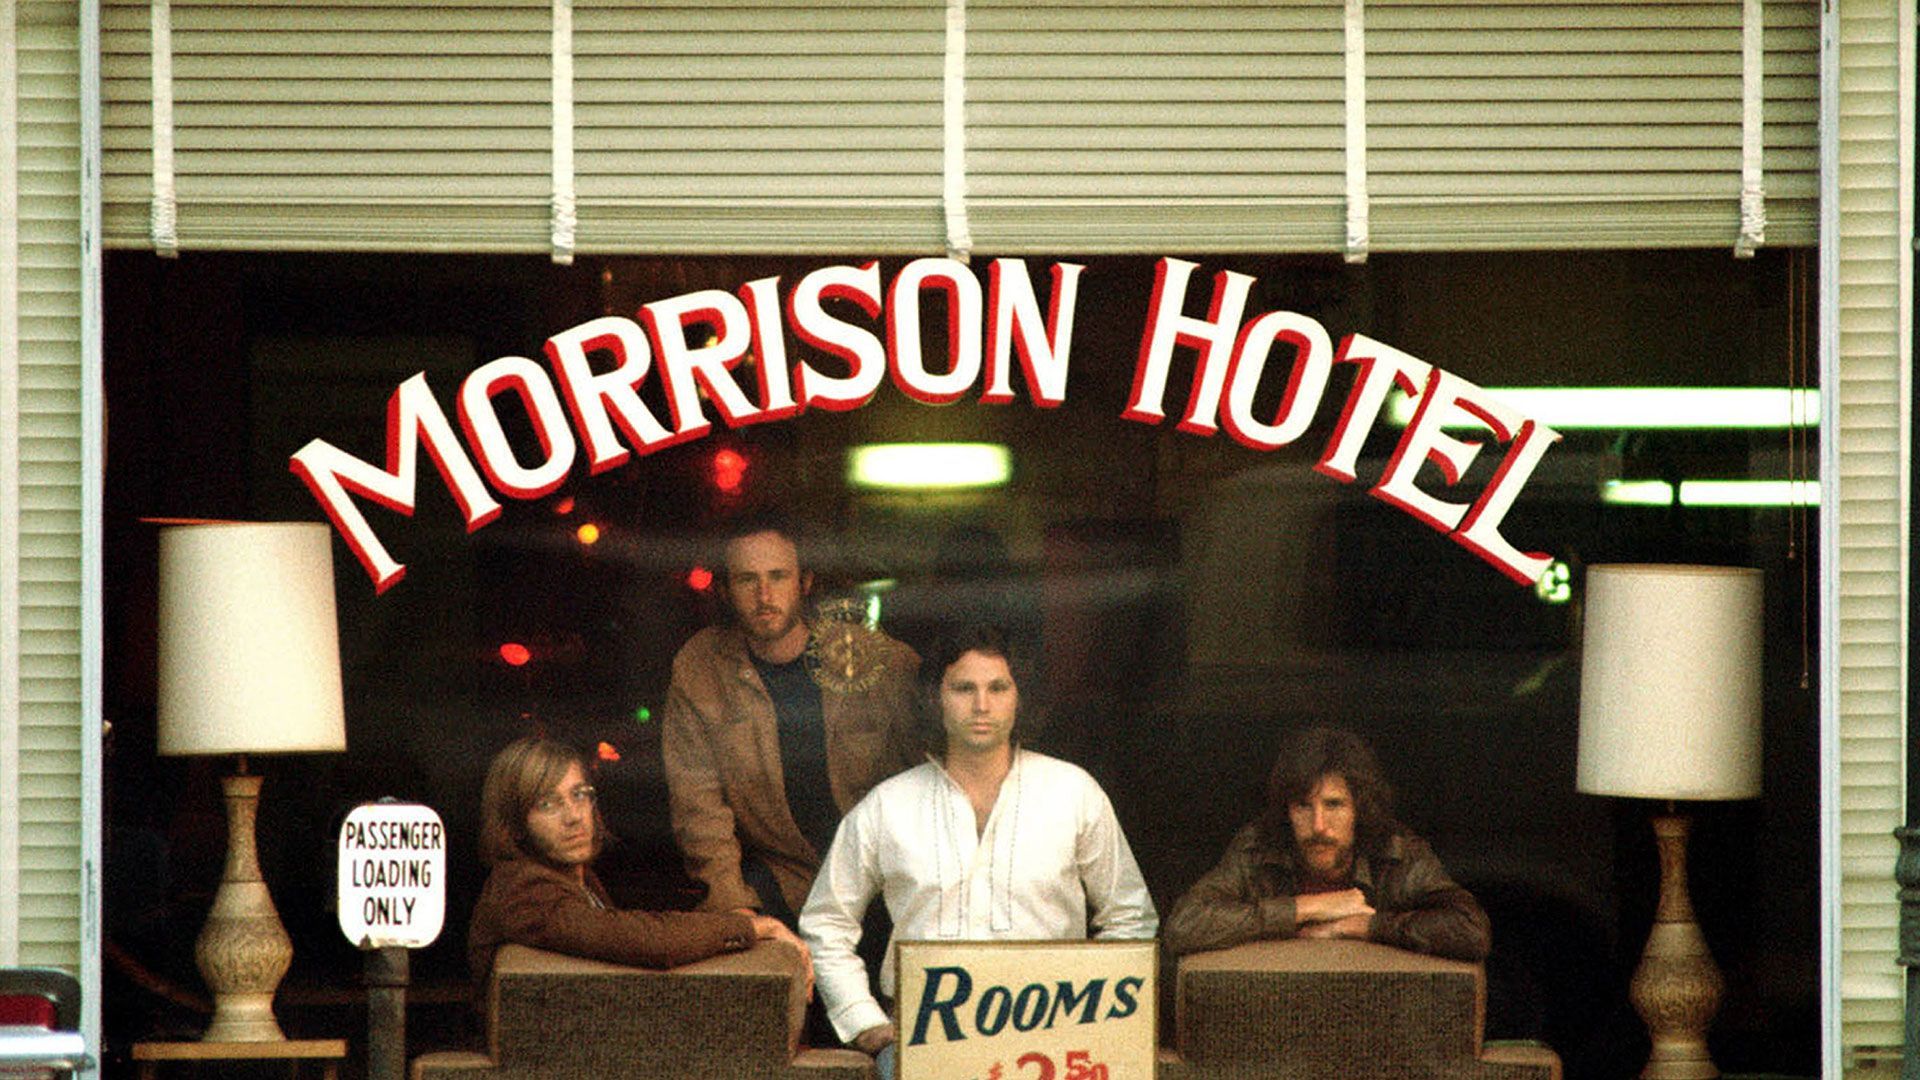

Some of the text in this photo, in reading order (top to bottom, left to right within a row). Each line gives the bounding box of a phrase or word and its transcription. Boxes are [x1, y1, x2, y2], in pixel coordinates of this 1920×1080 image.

[288, 257, 1563, 595] MORRISON HOTEL
[345, 821, 441, 850] PASSENGER
[352, 859, 431, 888] LOADING
[363, 896, 416, 926] ONLY
